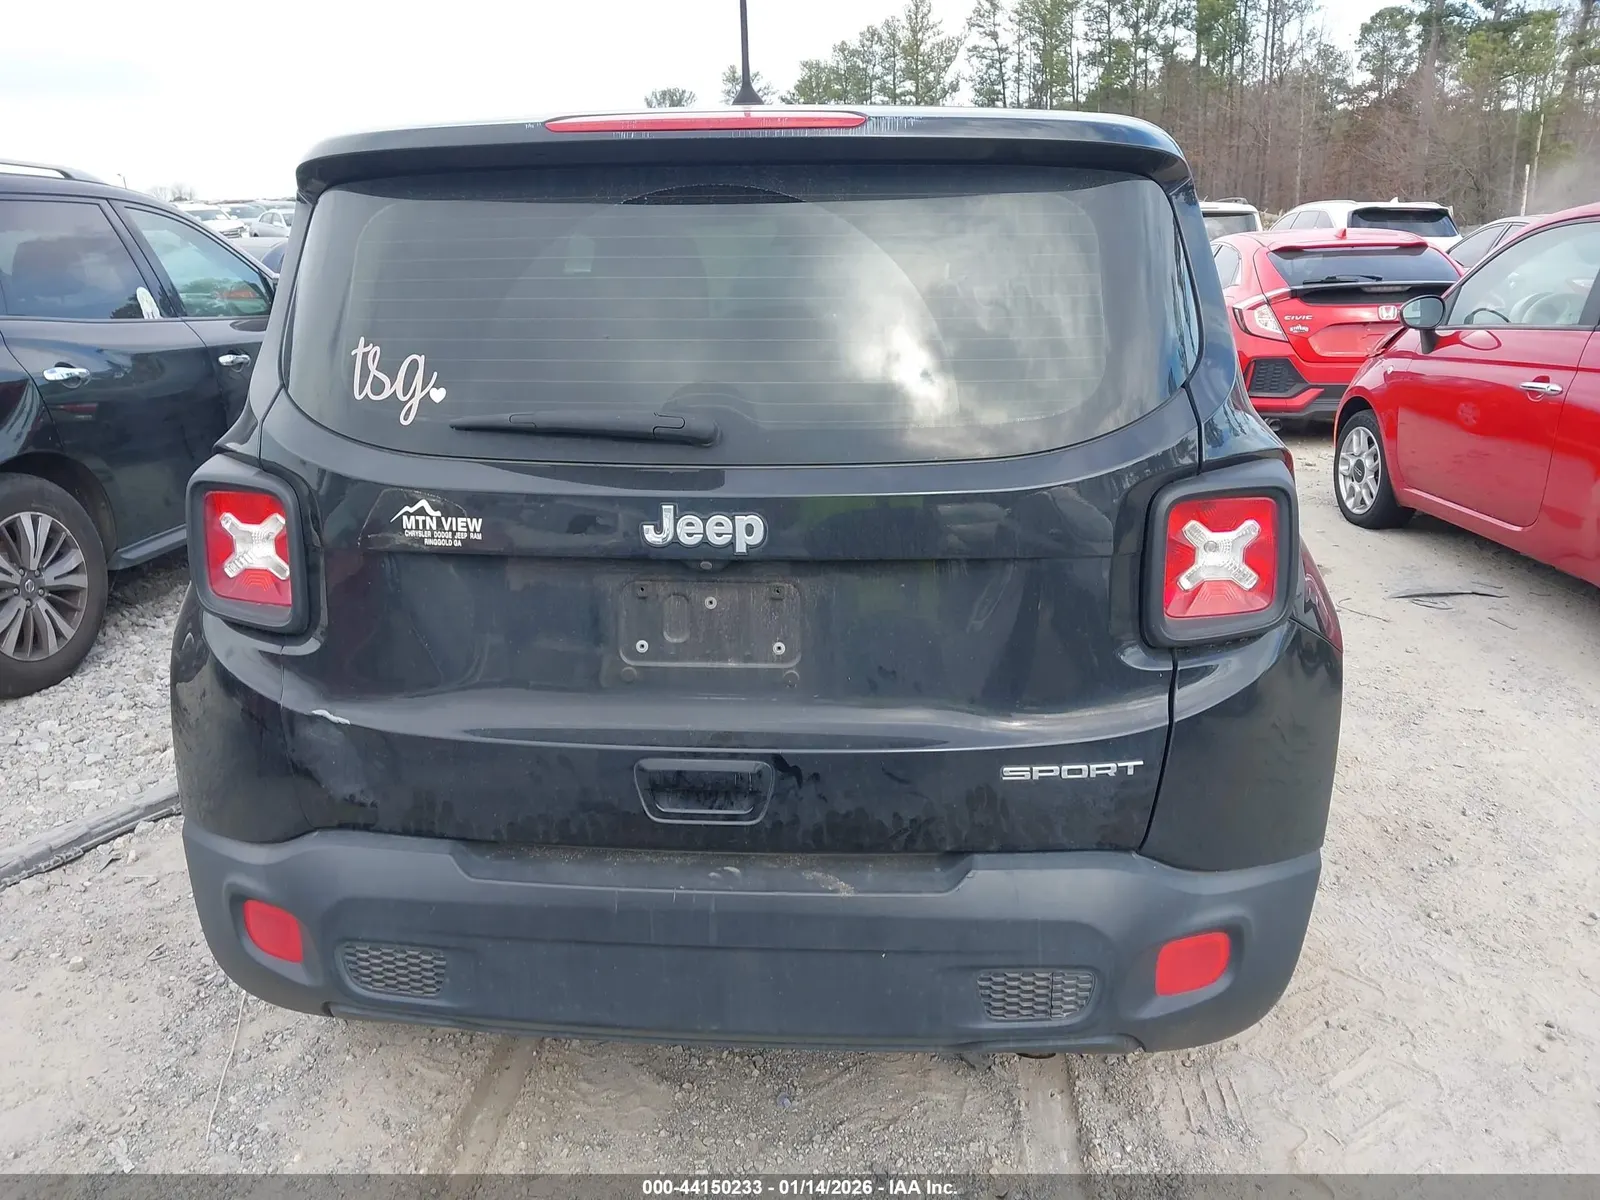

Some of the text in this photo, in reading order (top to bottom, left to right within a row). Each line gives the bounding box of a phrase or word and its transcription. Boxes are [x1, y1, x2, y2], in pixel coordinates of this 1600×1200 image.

[402, 515, 482, 532] MTN VIEW
[642, 504, 765, 554] Jeep
[404, 530, 431, 538] CHRYSLER
[433, 531, 452, 539] DODGE
[1001, 760, 1144, 781] SPORT
